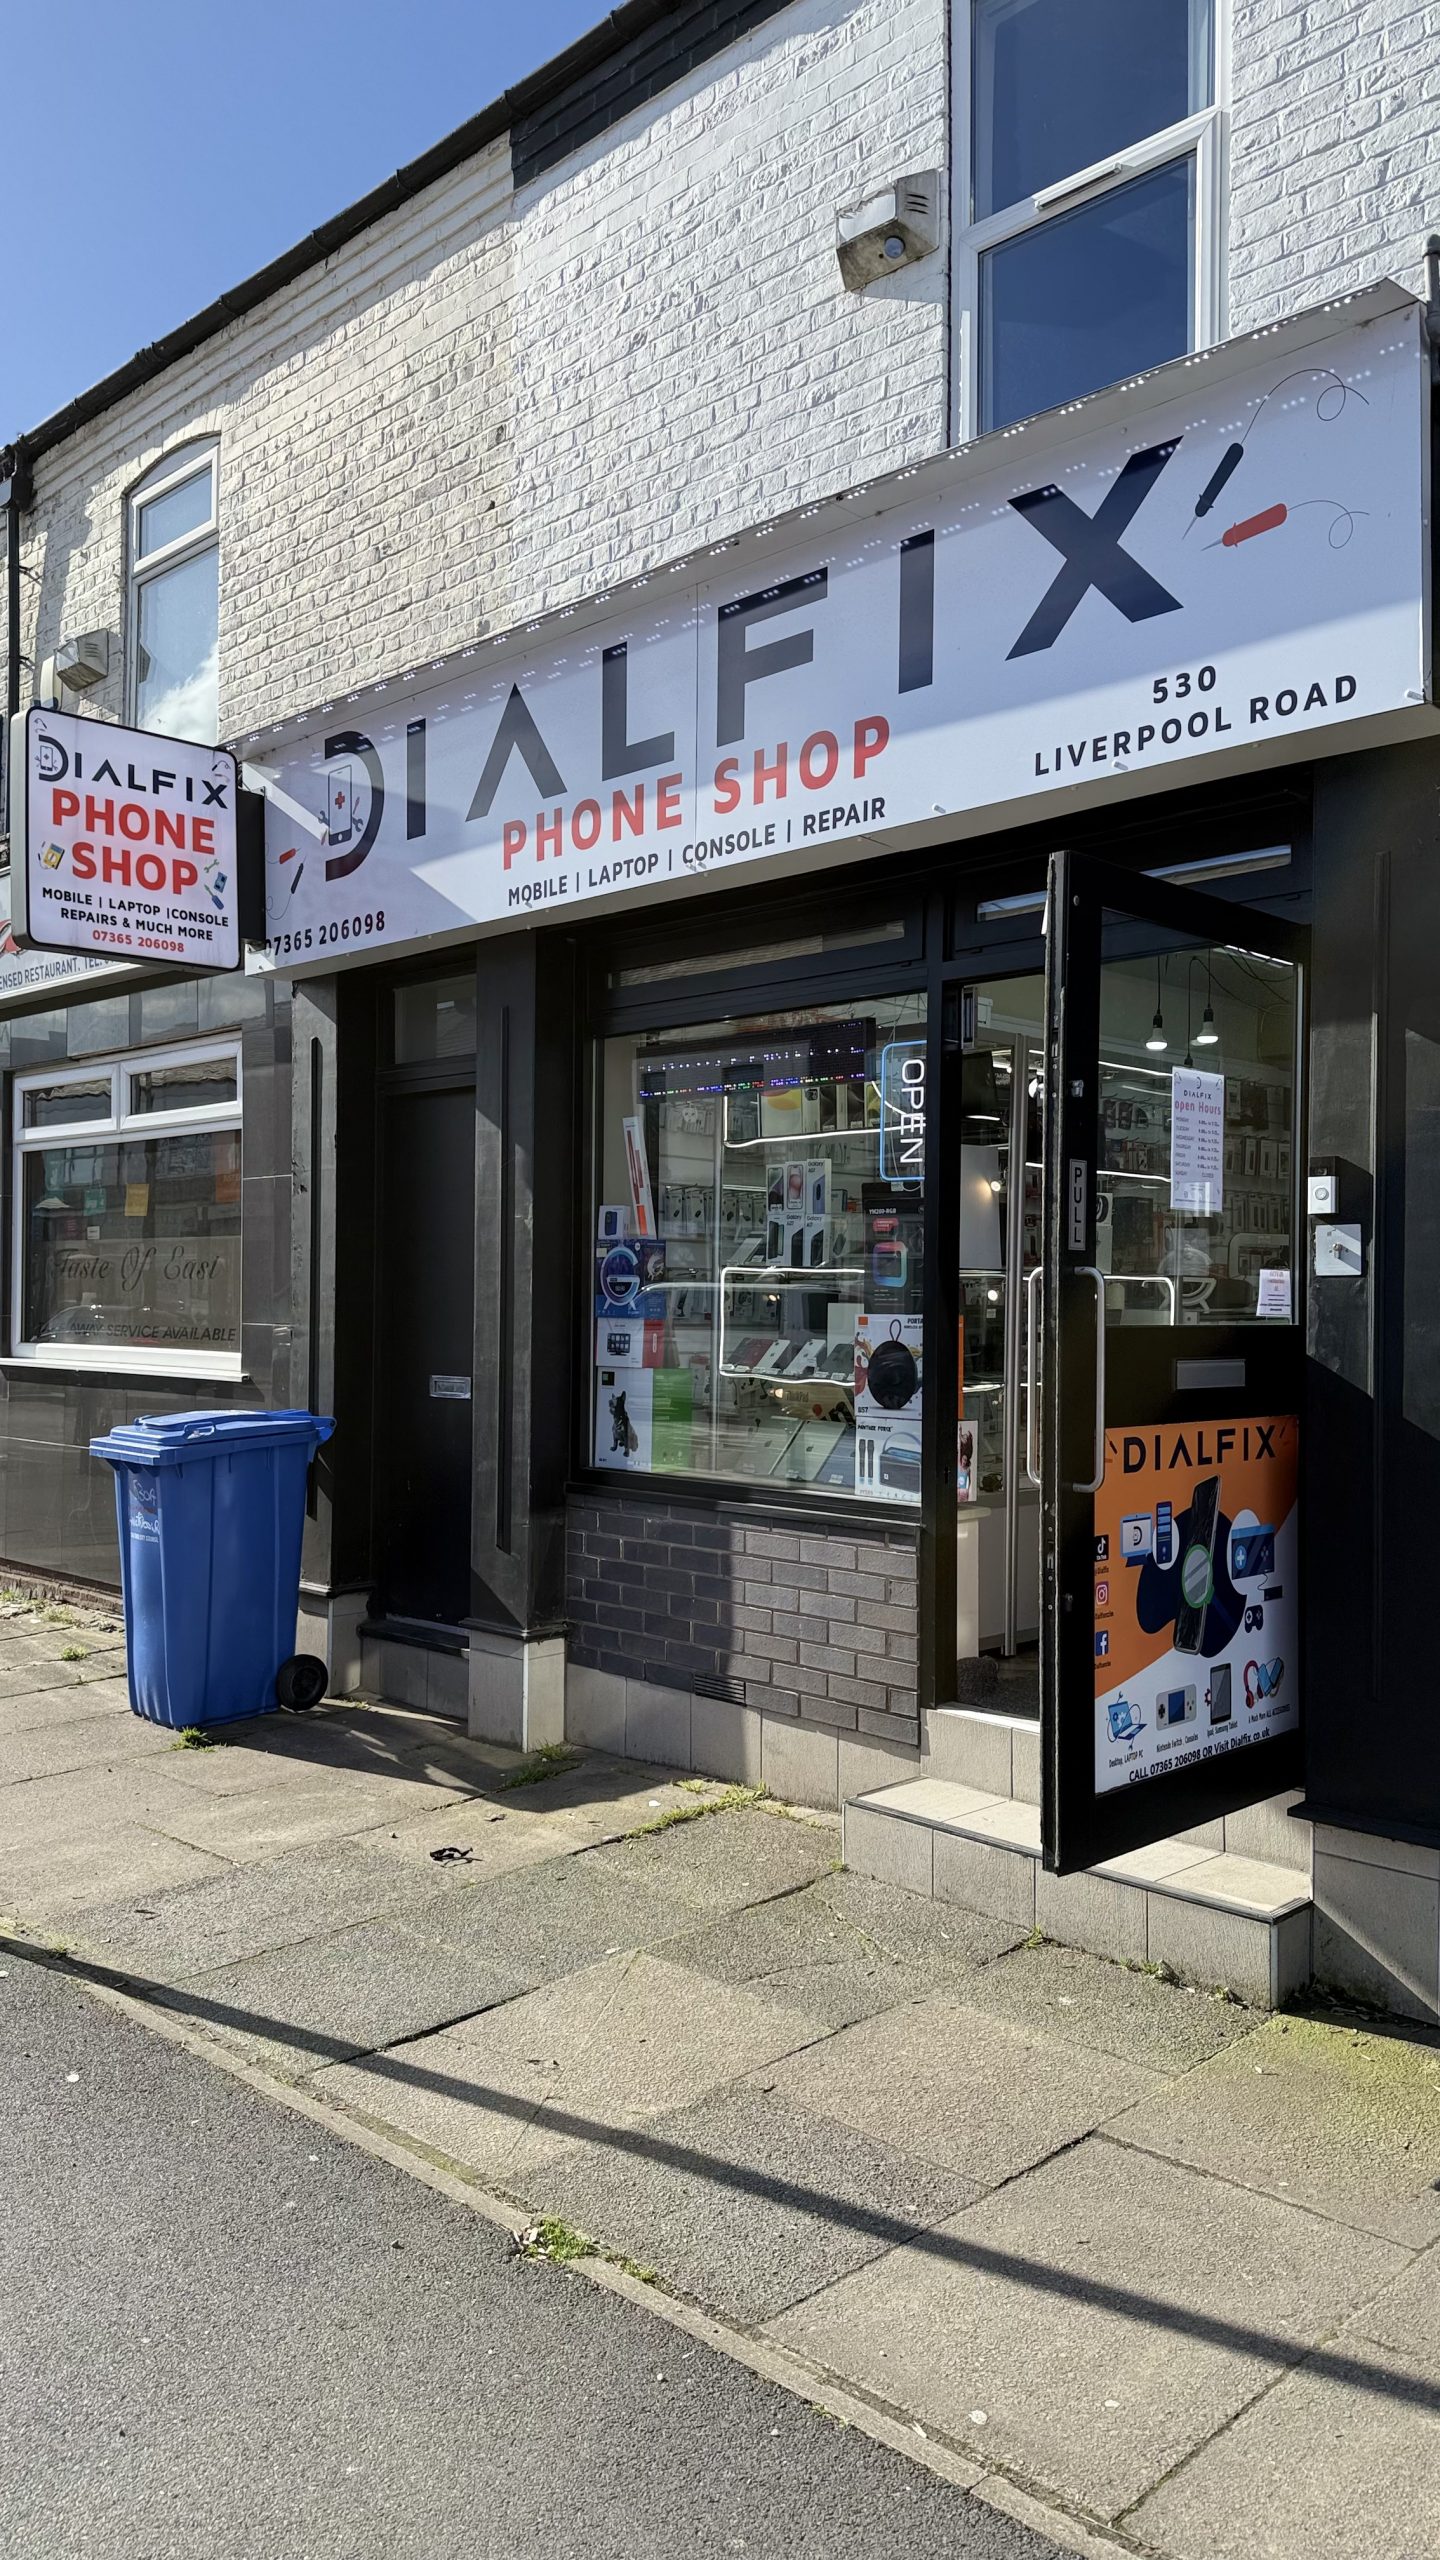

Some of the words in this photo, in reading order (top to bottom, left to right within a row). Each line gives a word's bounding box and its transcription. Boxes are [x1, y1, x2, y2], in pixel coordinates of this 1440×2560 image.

[325, 434, 1184, 882] DIALFIX
[1152, 665, 1216, 704] 530
[1035, 705, 1232, 776] LIVERPOOL
[1250, 674, 1357, 724] ROAD
[38, 734, 228, 810] DIALFIX
[504, 773, 683, 871] PHONE
[714, 715, 890, 816] SHOP
[52, 787, 215, 855] PHONE
[71, 841, 198, 895] SHOP
[508, 875, 568, 907] MOBILE
[588, 855, 659, 888] LAPTOP
[682, 827, 776, 867] CONSOLE
[803, 797, 886, 838] REPAIR
[42, 887, 92, 906] MOBILE
[109, 897, 160, 917] LAPTOP
[61, 907, 117, 927] REPAIRS
[122, 917, 130, 928] &
[135, 919, 173, 935] MUCH
[178, 925, 213, 941] MORE
[92, 929, 132, 945] 07365
[137, 936, 185, 953] 206098
[264, 928, 312, 958] 07365
[319, 910, 385, 945] 206098
[25, 957, 80, 983] RESTAURANT.
[900, 1058, 925, 1164] OPEN
[1174, 1101, 1194, 1113] open
[1198, 1102, 1220, 1115] Hours
[1184, 1090, 1212, 1100] DIALFIX
[1073, 1167, 1083, 1243] PULL
[121, 1246, 157, 1292] Of
[164, 1245, 223, 1281] East
[106, 1324, 160, 1339] SERVICE
[163, 1326, 236, 1341] AVAILABLE
[1123, 1425, 1276, 1473] DIALFIX
[1129, 1767, 1148, 1782] CALL
[1150, 1758, 1172, 1775] 07365
[1174, 1746, 1200, 1768] 206098
[1202, 1746, 1212, 1758] OR
[1214, 1740, 1229, 1753] Visit
